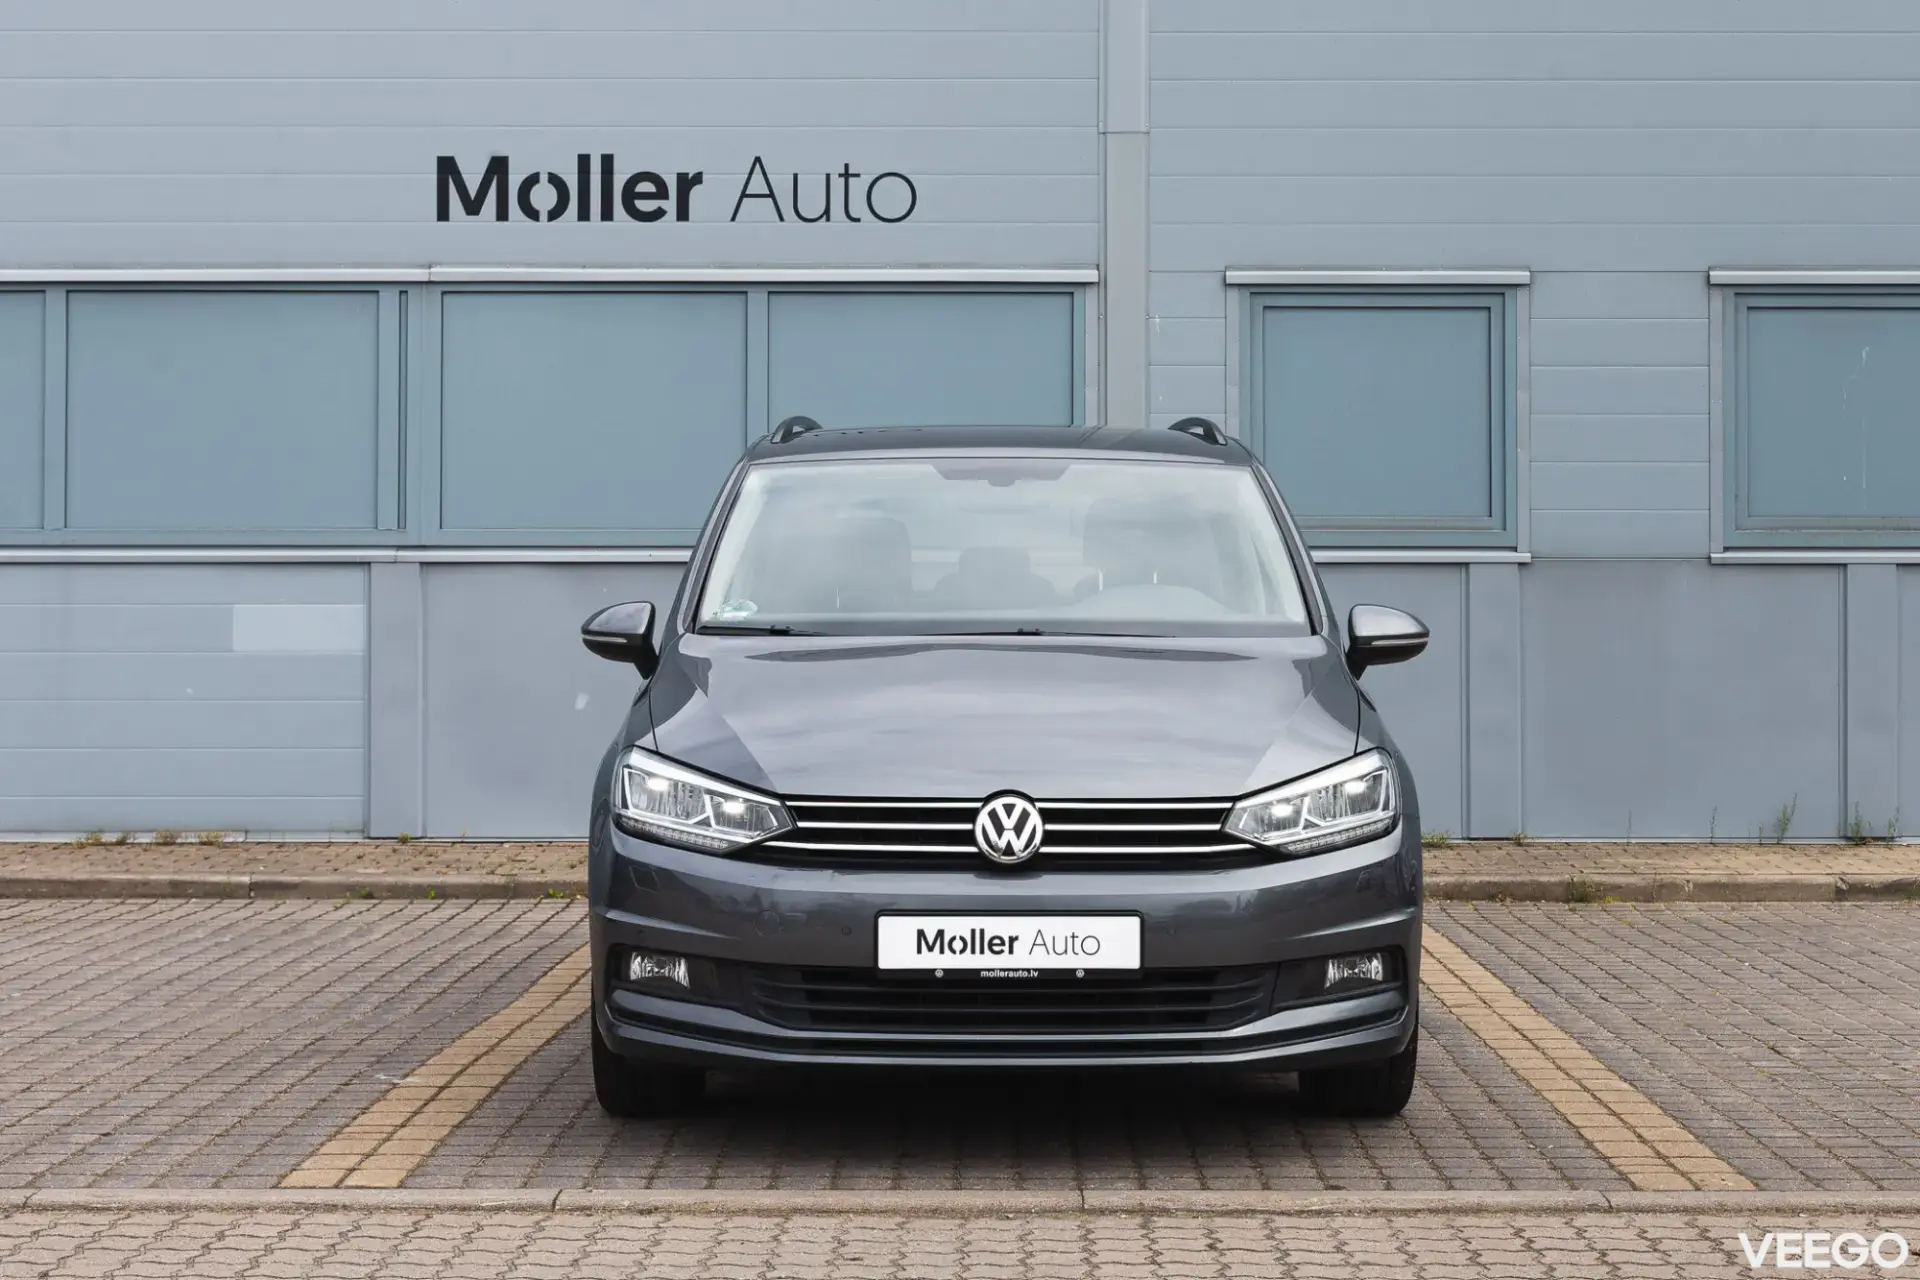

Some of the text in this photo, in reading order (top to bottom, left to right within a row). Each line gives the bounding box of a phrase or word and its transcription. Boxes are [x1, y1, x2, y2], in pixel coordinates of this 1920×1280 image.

[436, 153, 918, 223] Moller Auto
[977, 798, 1041, 861] VW
[916, 928, 1101, 955] Moller Auto
[980, 969, 1039, 978] mollerauto.lv
